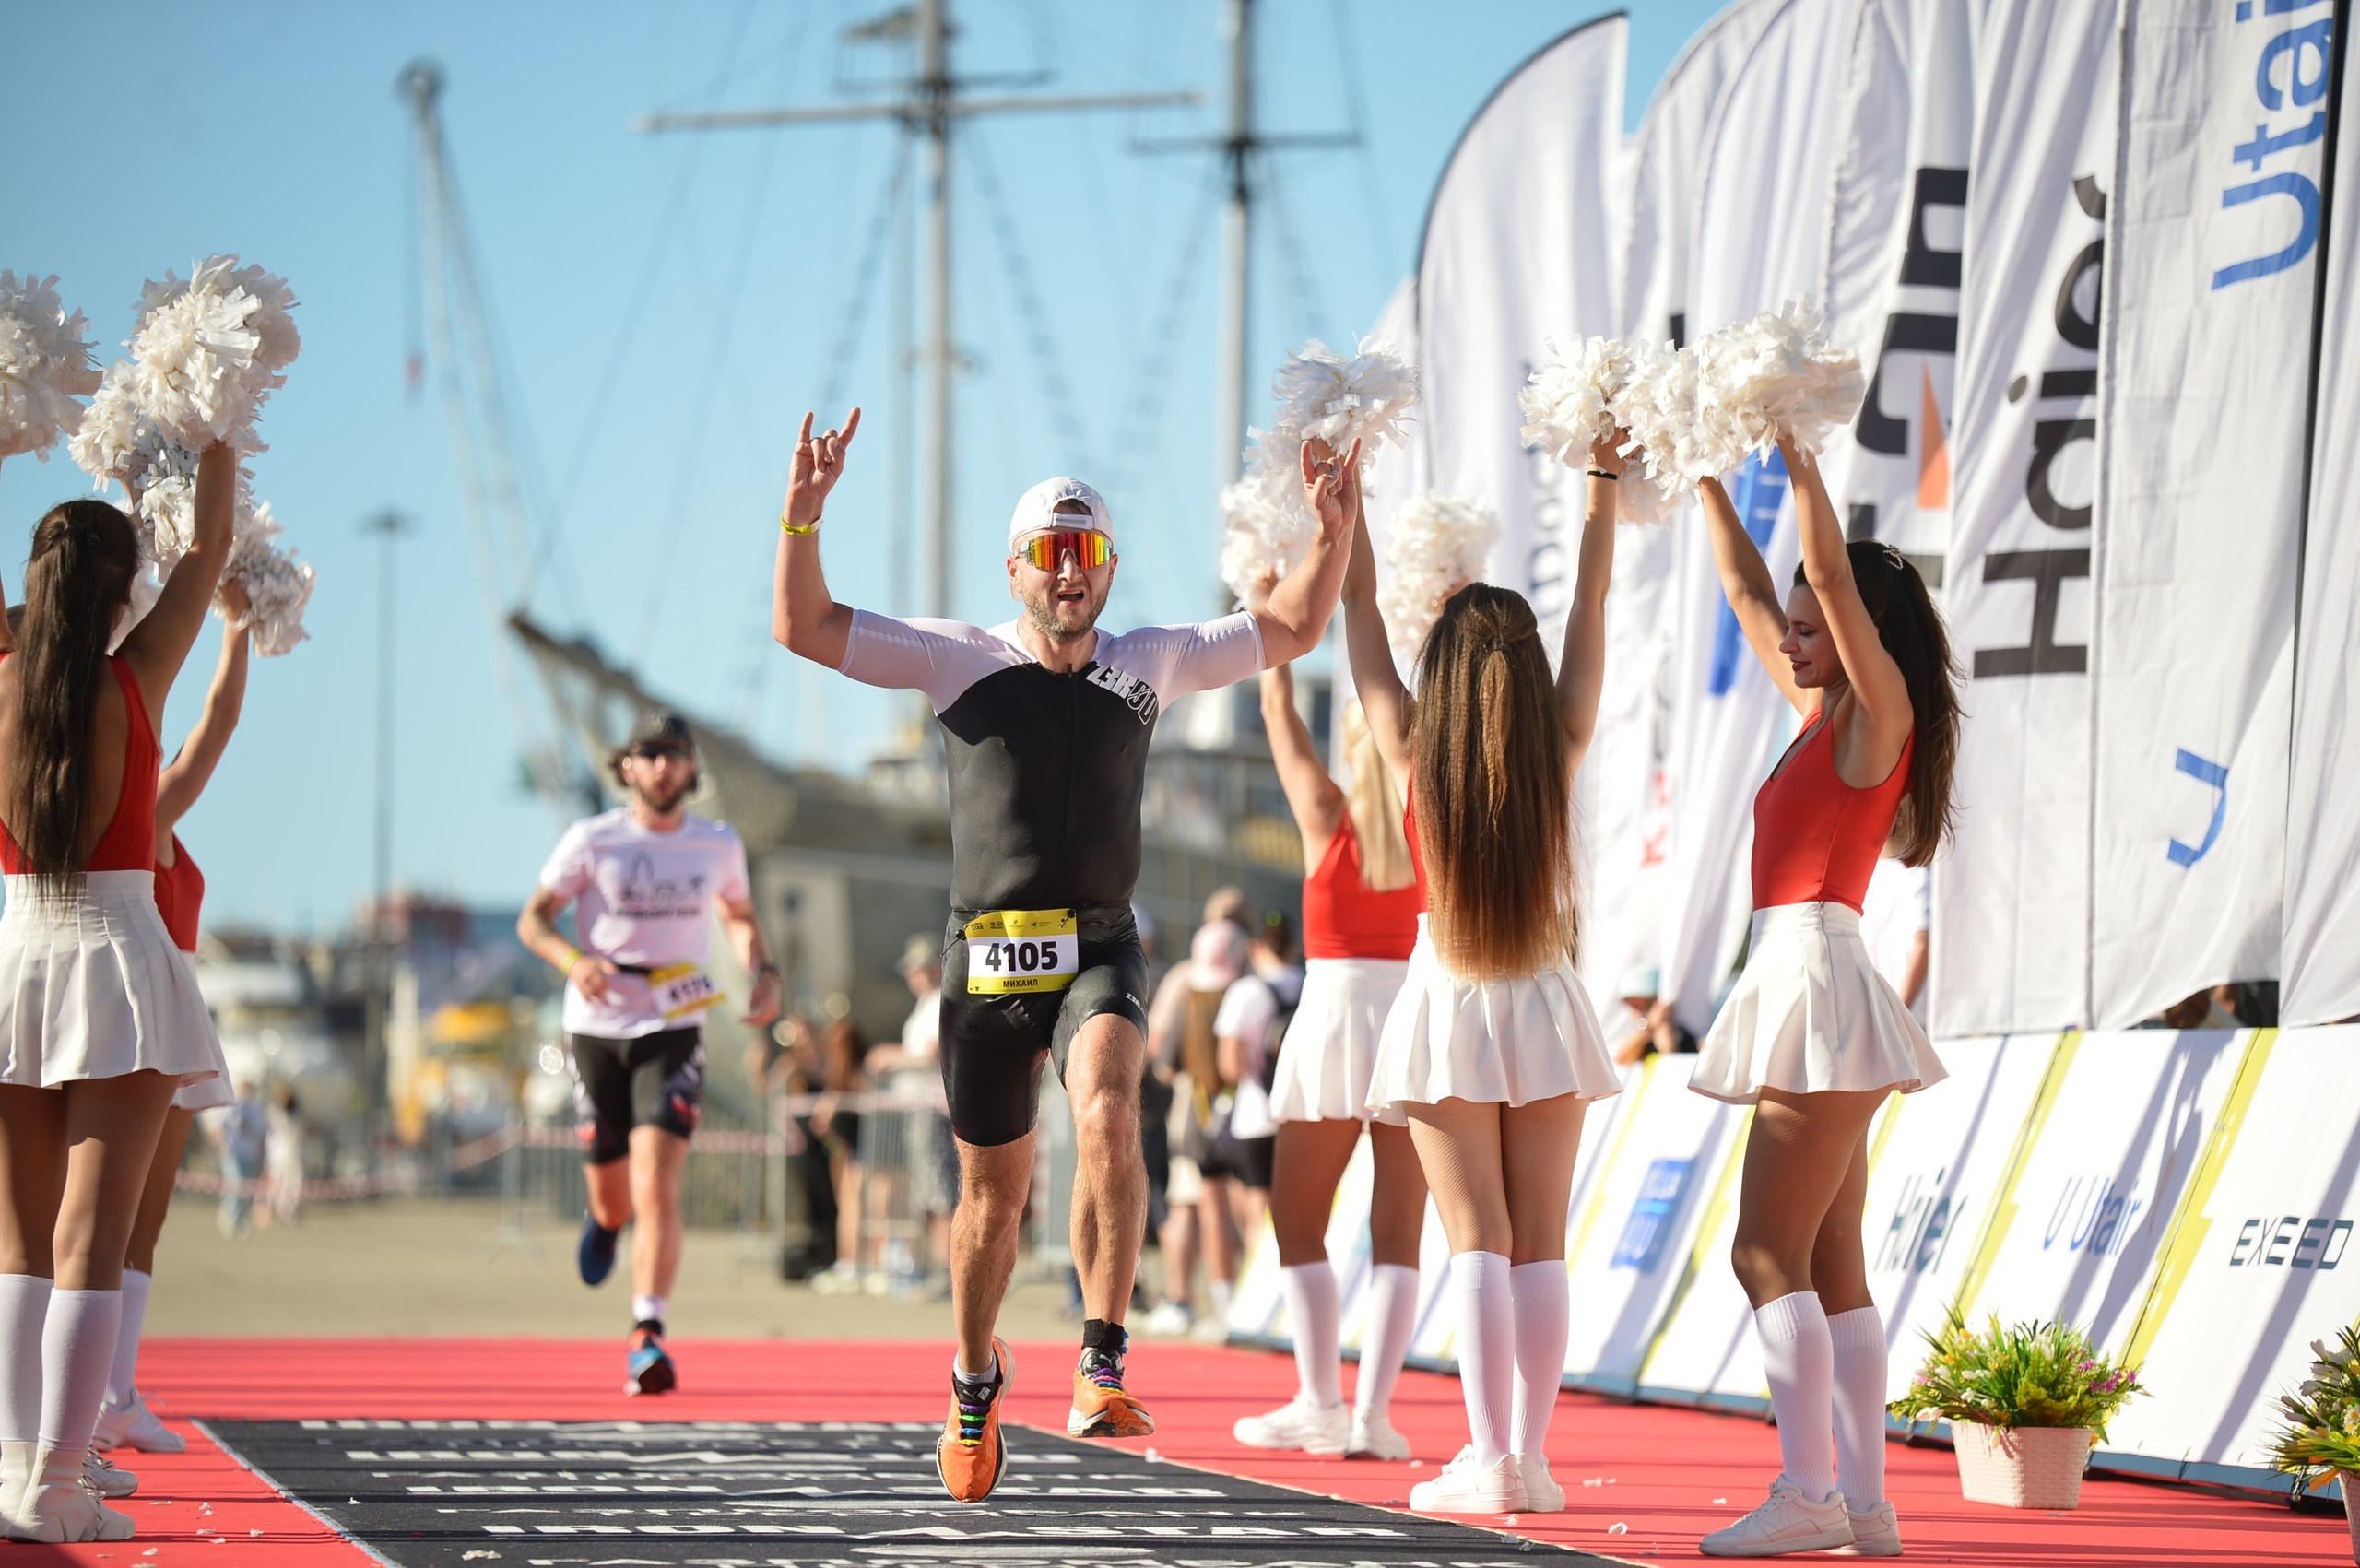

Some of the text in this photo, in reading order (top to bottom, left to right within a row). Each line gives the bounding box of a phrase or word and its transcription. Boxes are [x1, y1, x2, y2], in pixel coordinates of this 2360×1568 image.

[985, 941, 1058, 972] 4105
[1003, 979, 1038, 987] МИХАИЛ
[1873, 1167, 1969, 1274] Haier
[2071, 1176, 2143, 1256] Utair
[2229, 1216, 2354, 1269] EXEED
[478, 1525, 1409, 1537] IRON STAR
